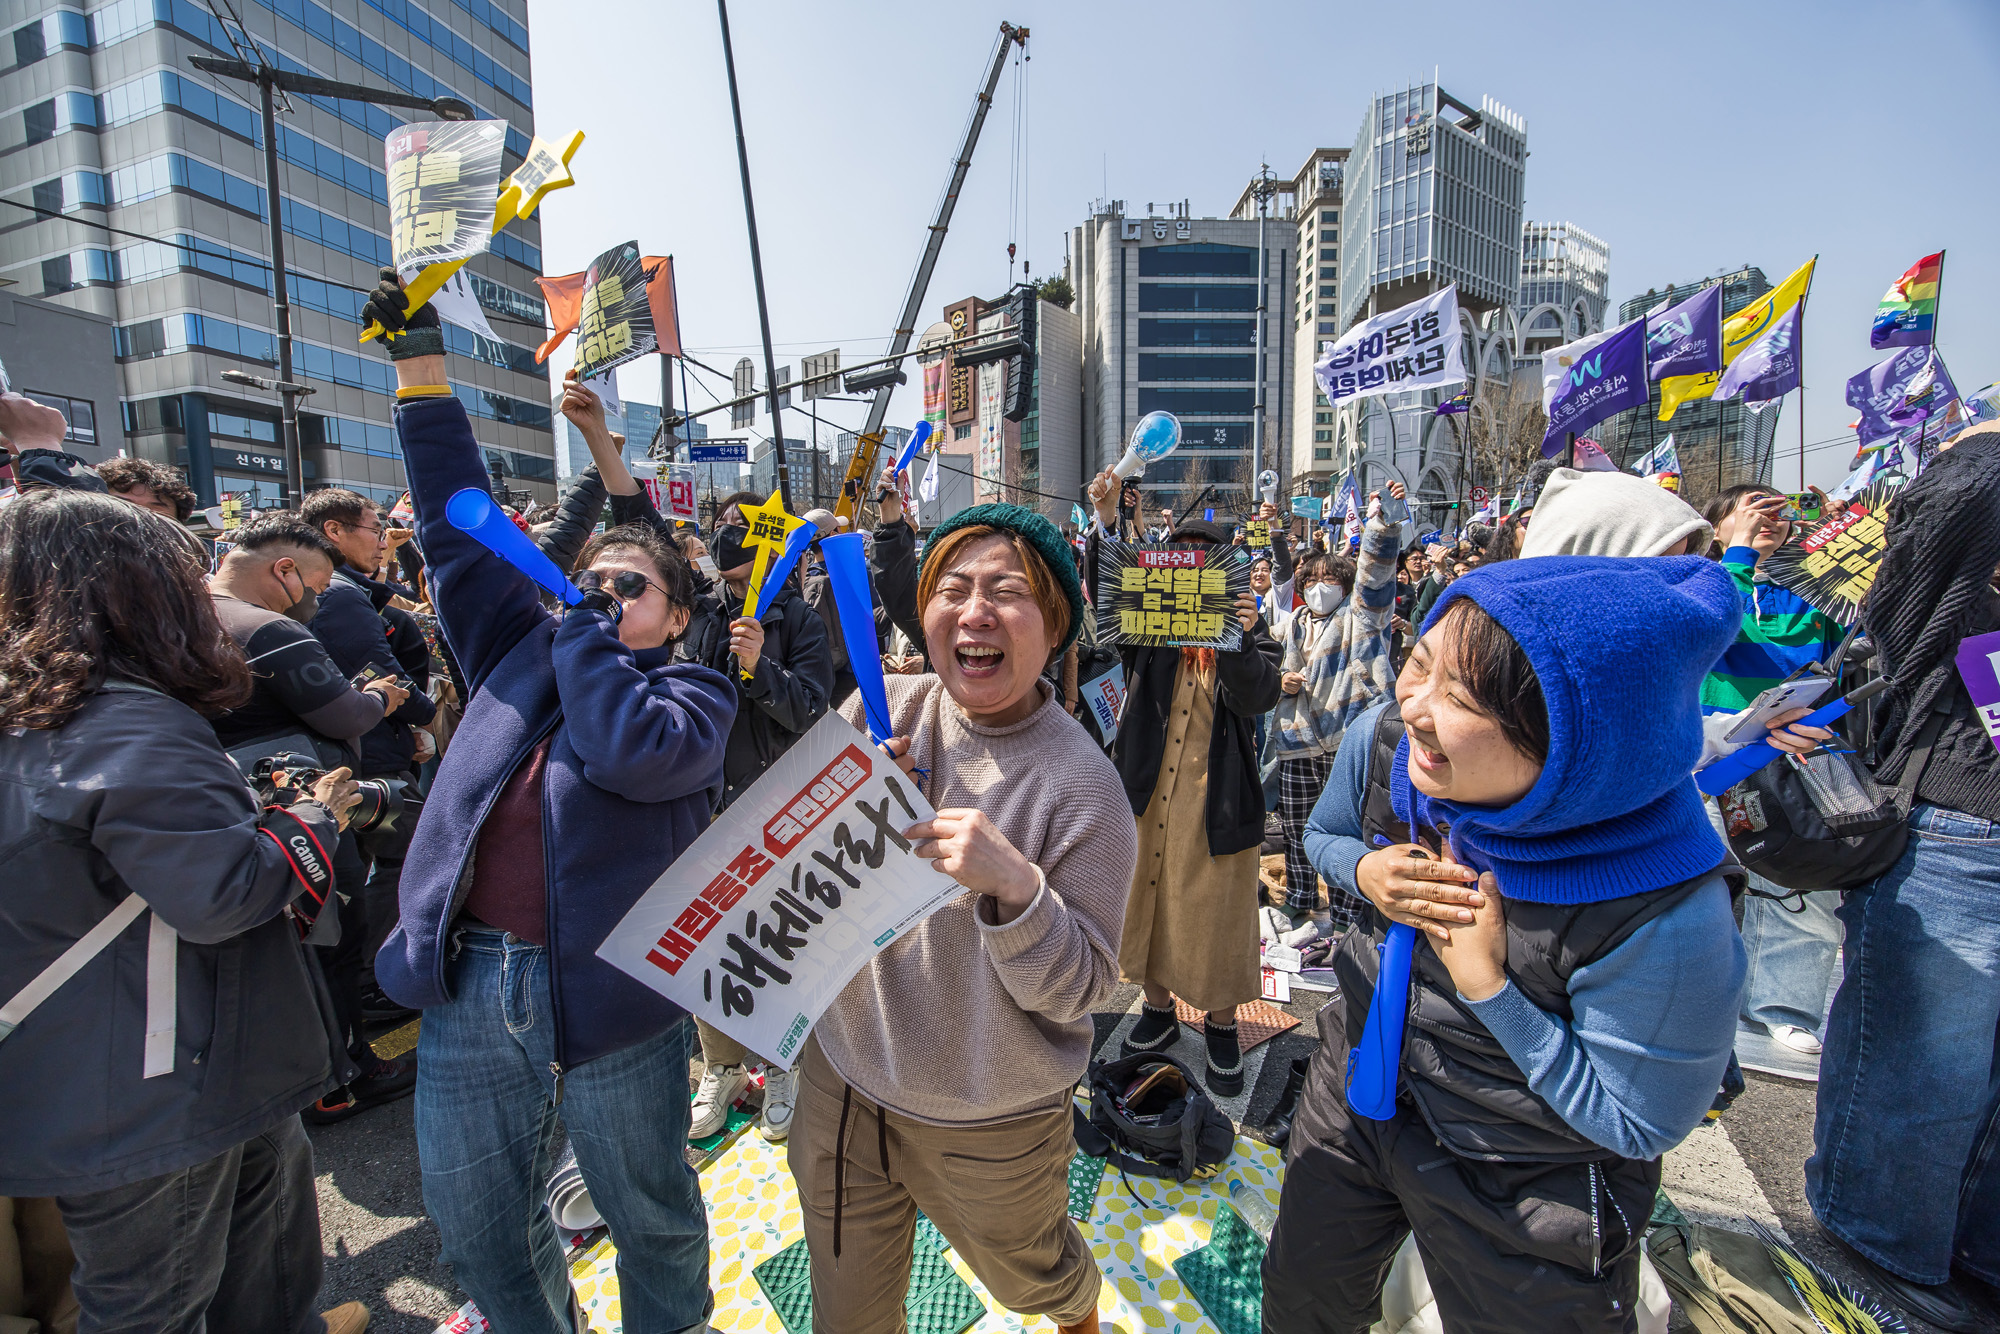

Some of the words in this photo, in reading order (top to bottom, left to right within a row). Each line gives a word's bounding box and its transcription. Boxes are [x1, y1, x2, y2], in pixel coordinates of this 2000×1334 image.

[514, 160, 547, 196] 파면
[1152, 220, 1191, 239] 동일
[236, 453, 289, 470] 신아일
[719, 446, 746, 455] 인사동길
[752, 521, 785, 542] 파면
[758, 512, 785, 527] 윤석열
[1806, 510, 1860, 548] 내란수괴
[1145, 551, 1196, 566] 내란수괴
[1121, 567, 1227, 595] 윤석열을
[1120, 610, 1225, 638] 파면하라
[1094, 694, 1115, 731] 헌재는
[767, 755, 867, 845] 국민의힘
[289, 835, 327, 883] Canon
[645, 844, 776, 977] 내란동조
[779, 1014, 810, 1060] 비상행동
